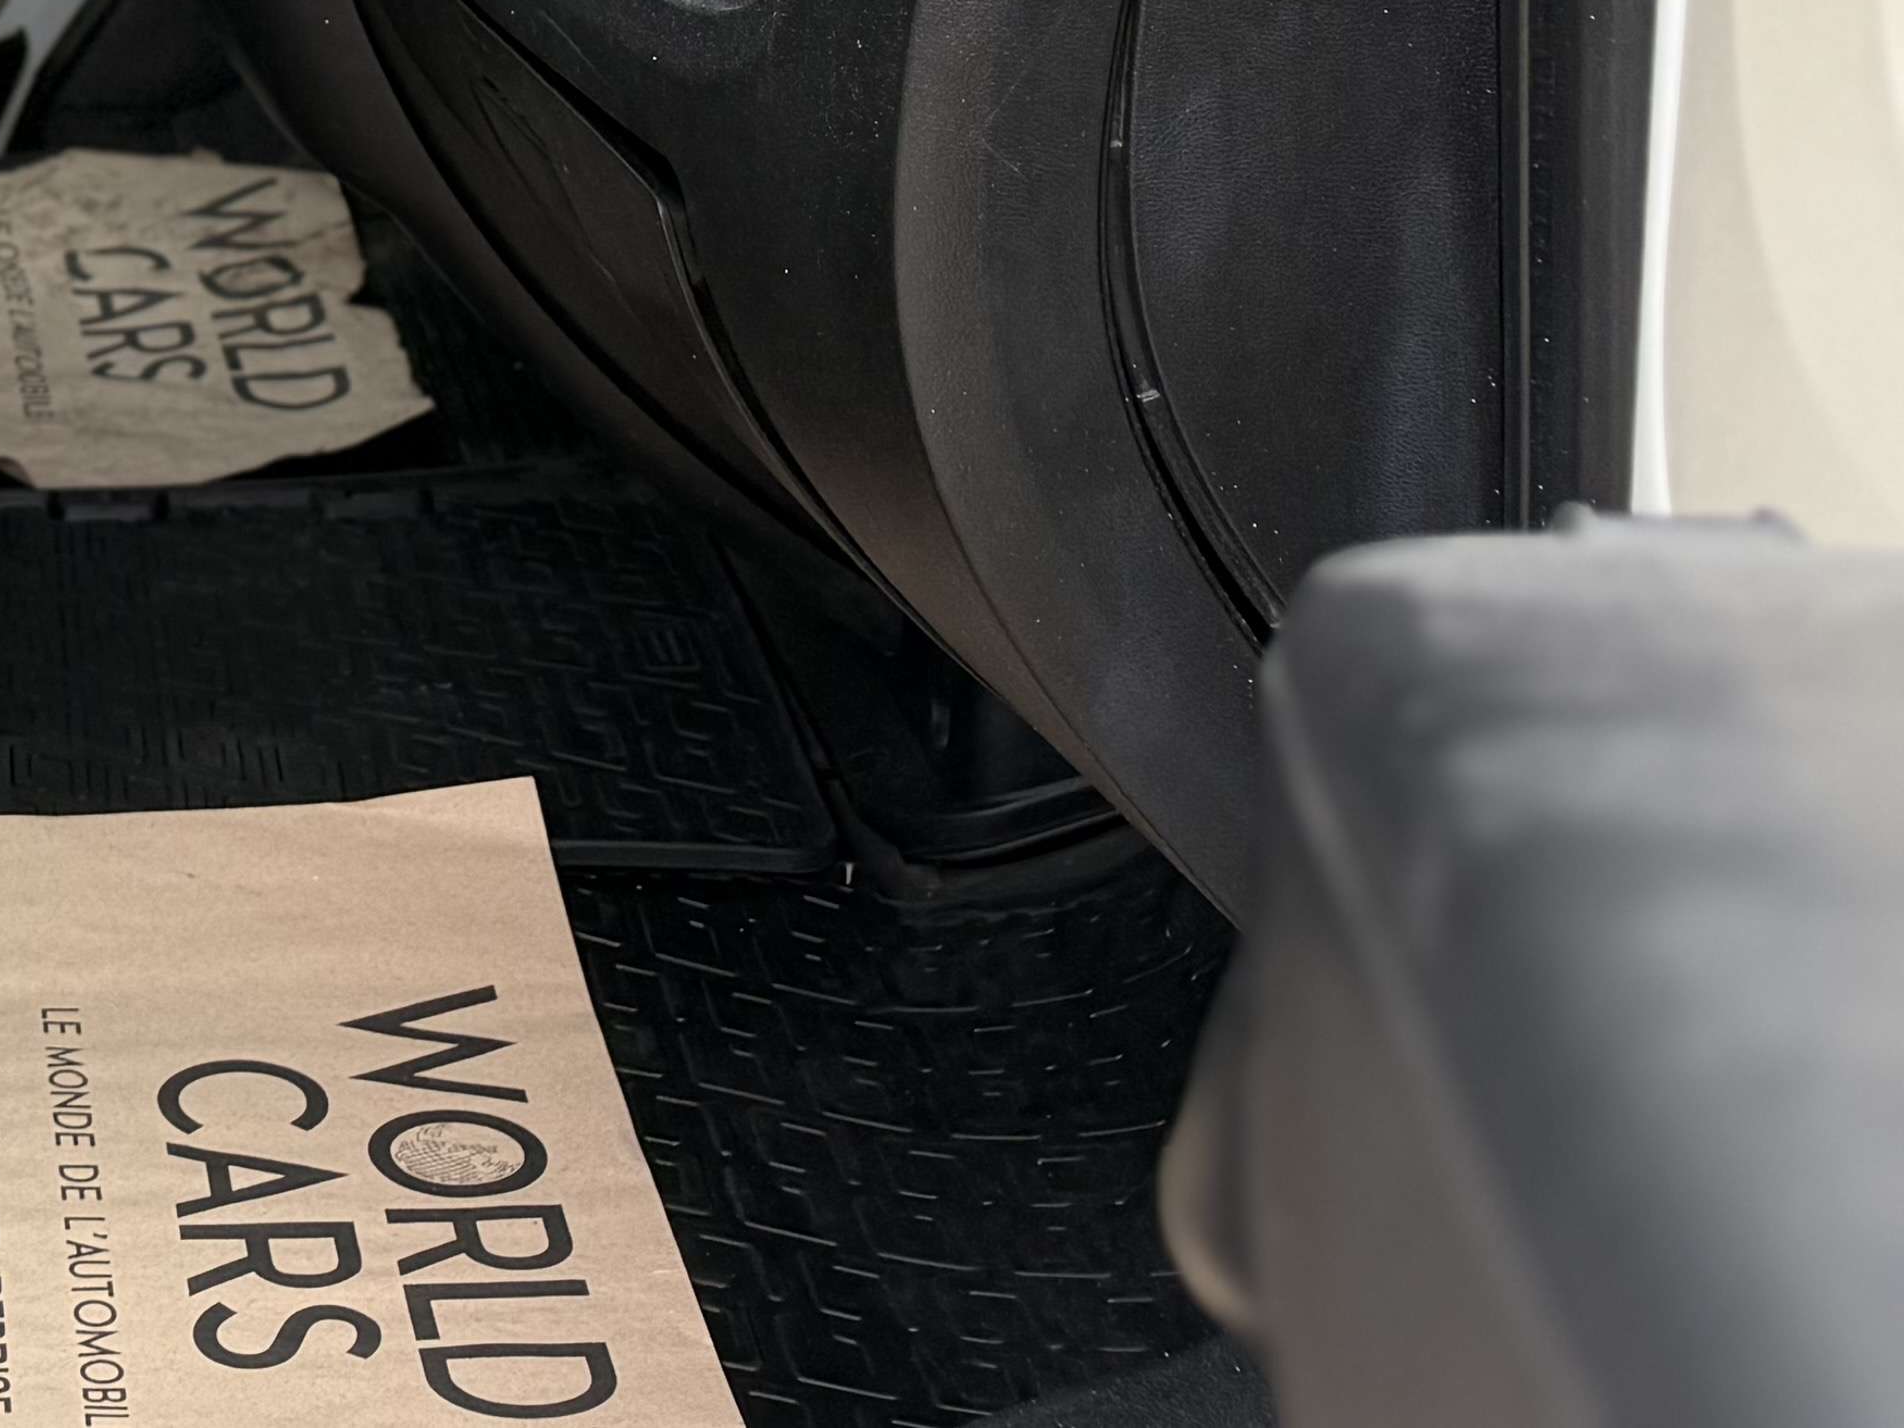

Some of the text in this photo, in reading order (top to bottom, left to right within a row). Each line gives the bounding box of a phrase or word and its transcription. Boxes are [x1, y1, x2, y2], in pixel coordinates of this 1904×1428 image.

[64, 244, 207, 383] CARS
[185, 177, 351, 412] WORLD
[40, 1007, 83, 1036] LE
[44, 1046, 97, 1148] MONDE
[57, 1164, 103, 1202] DE
[156, 1059, 383, 1370] CARS
[336, 984, 618, 1420] WORLD
